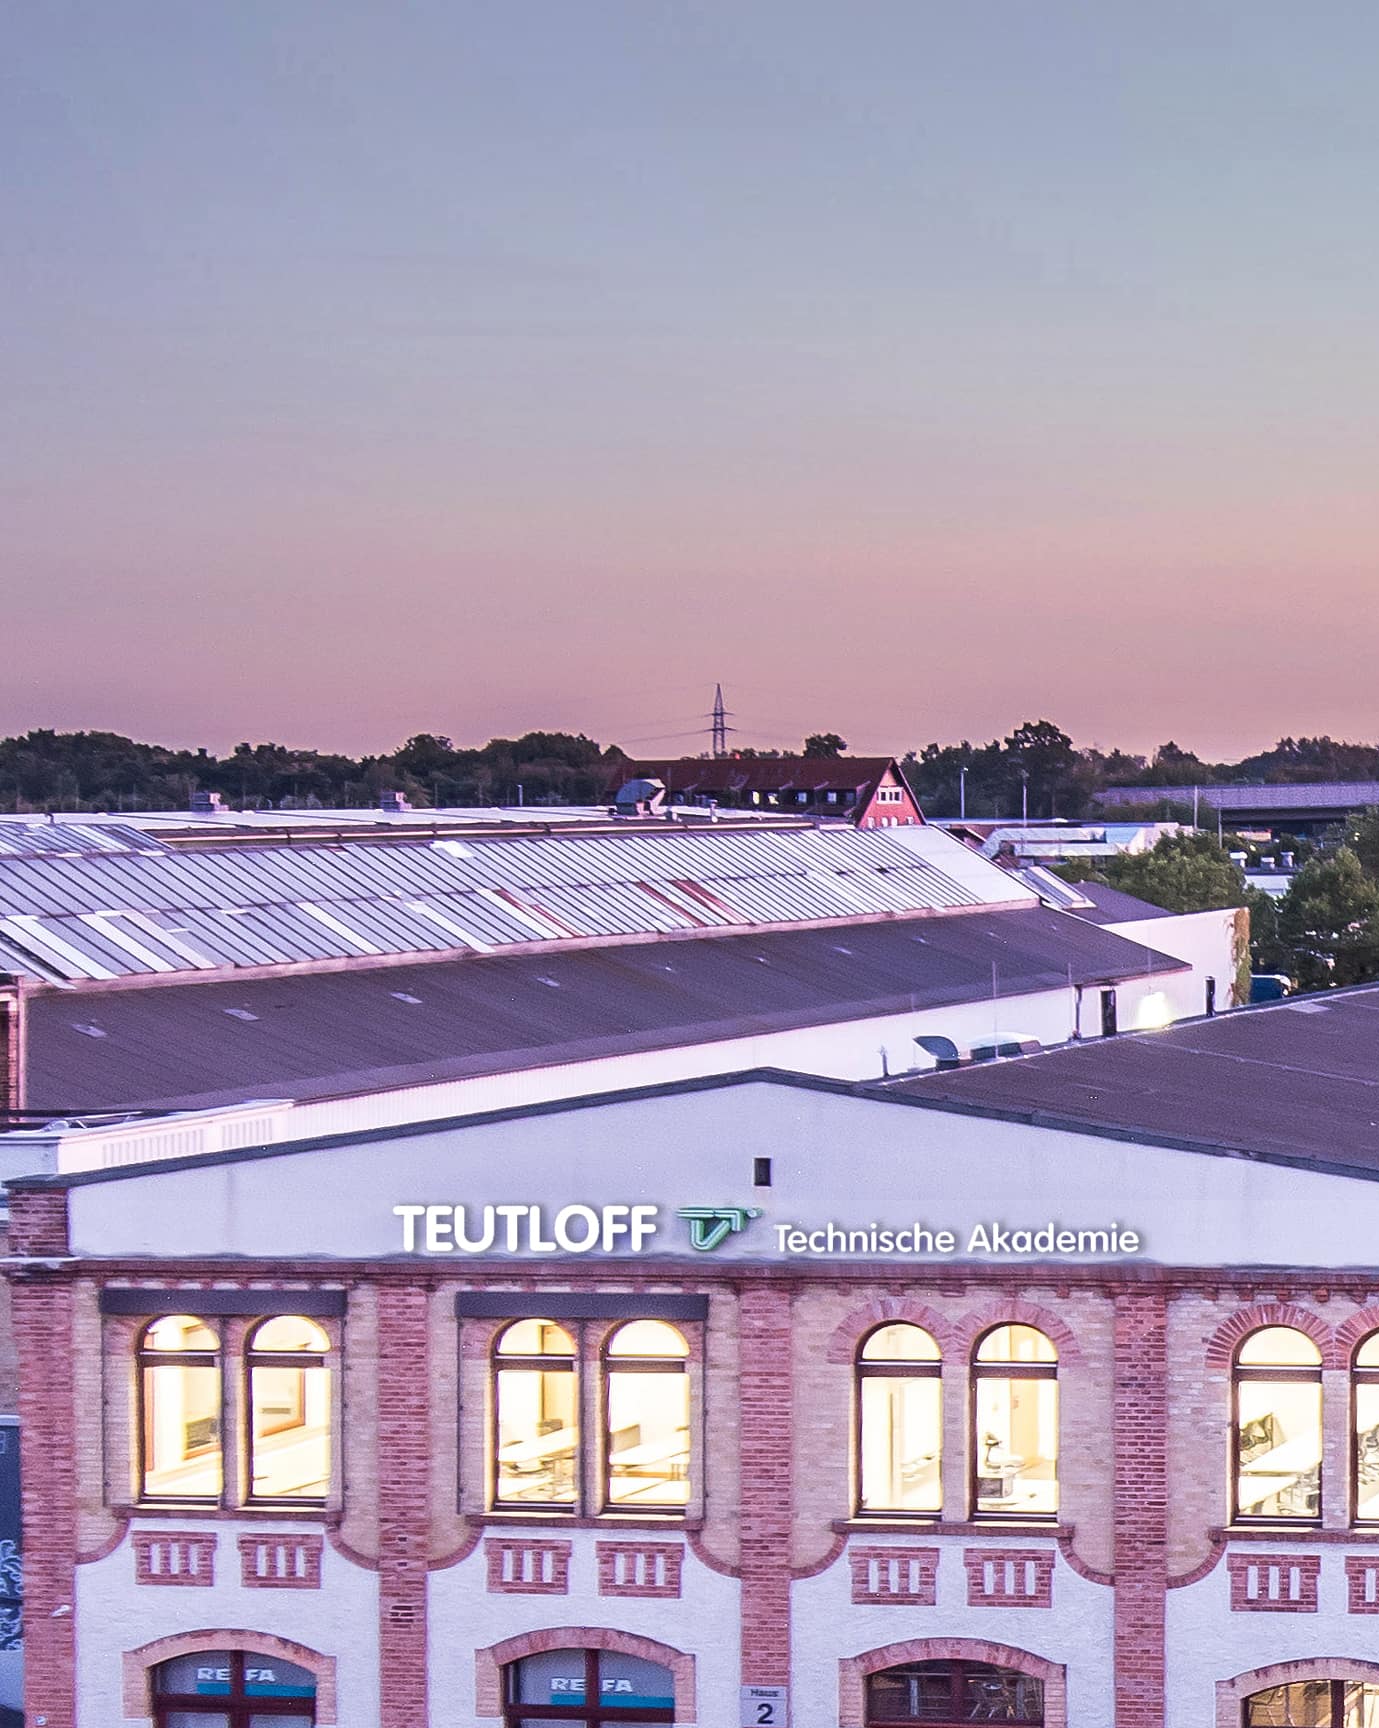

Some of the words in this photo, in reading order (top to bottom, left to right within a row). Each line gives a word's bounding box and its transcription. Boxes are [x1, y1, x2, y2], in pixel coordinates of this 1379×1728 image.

[393, 1205, 658, 1253] TEUTLOFF
[775, 1222, 954, 1253] Technische
[967, 1222, 1139, 1253] Akademie
[197, 1667, 276, 1682] REFA
[550, 1678, 634, 1693] REFA
[750, 1688, 780, 1698] Haus
[756, 1702, 775, 1725] 2
